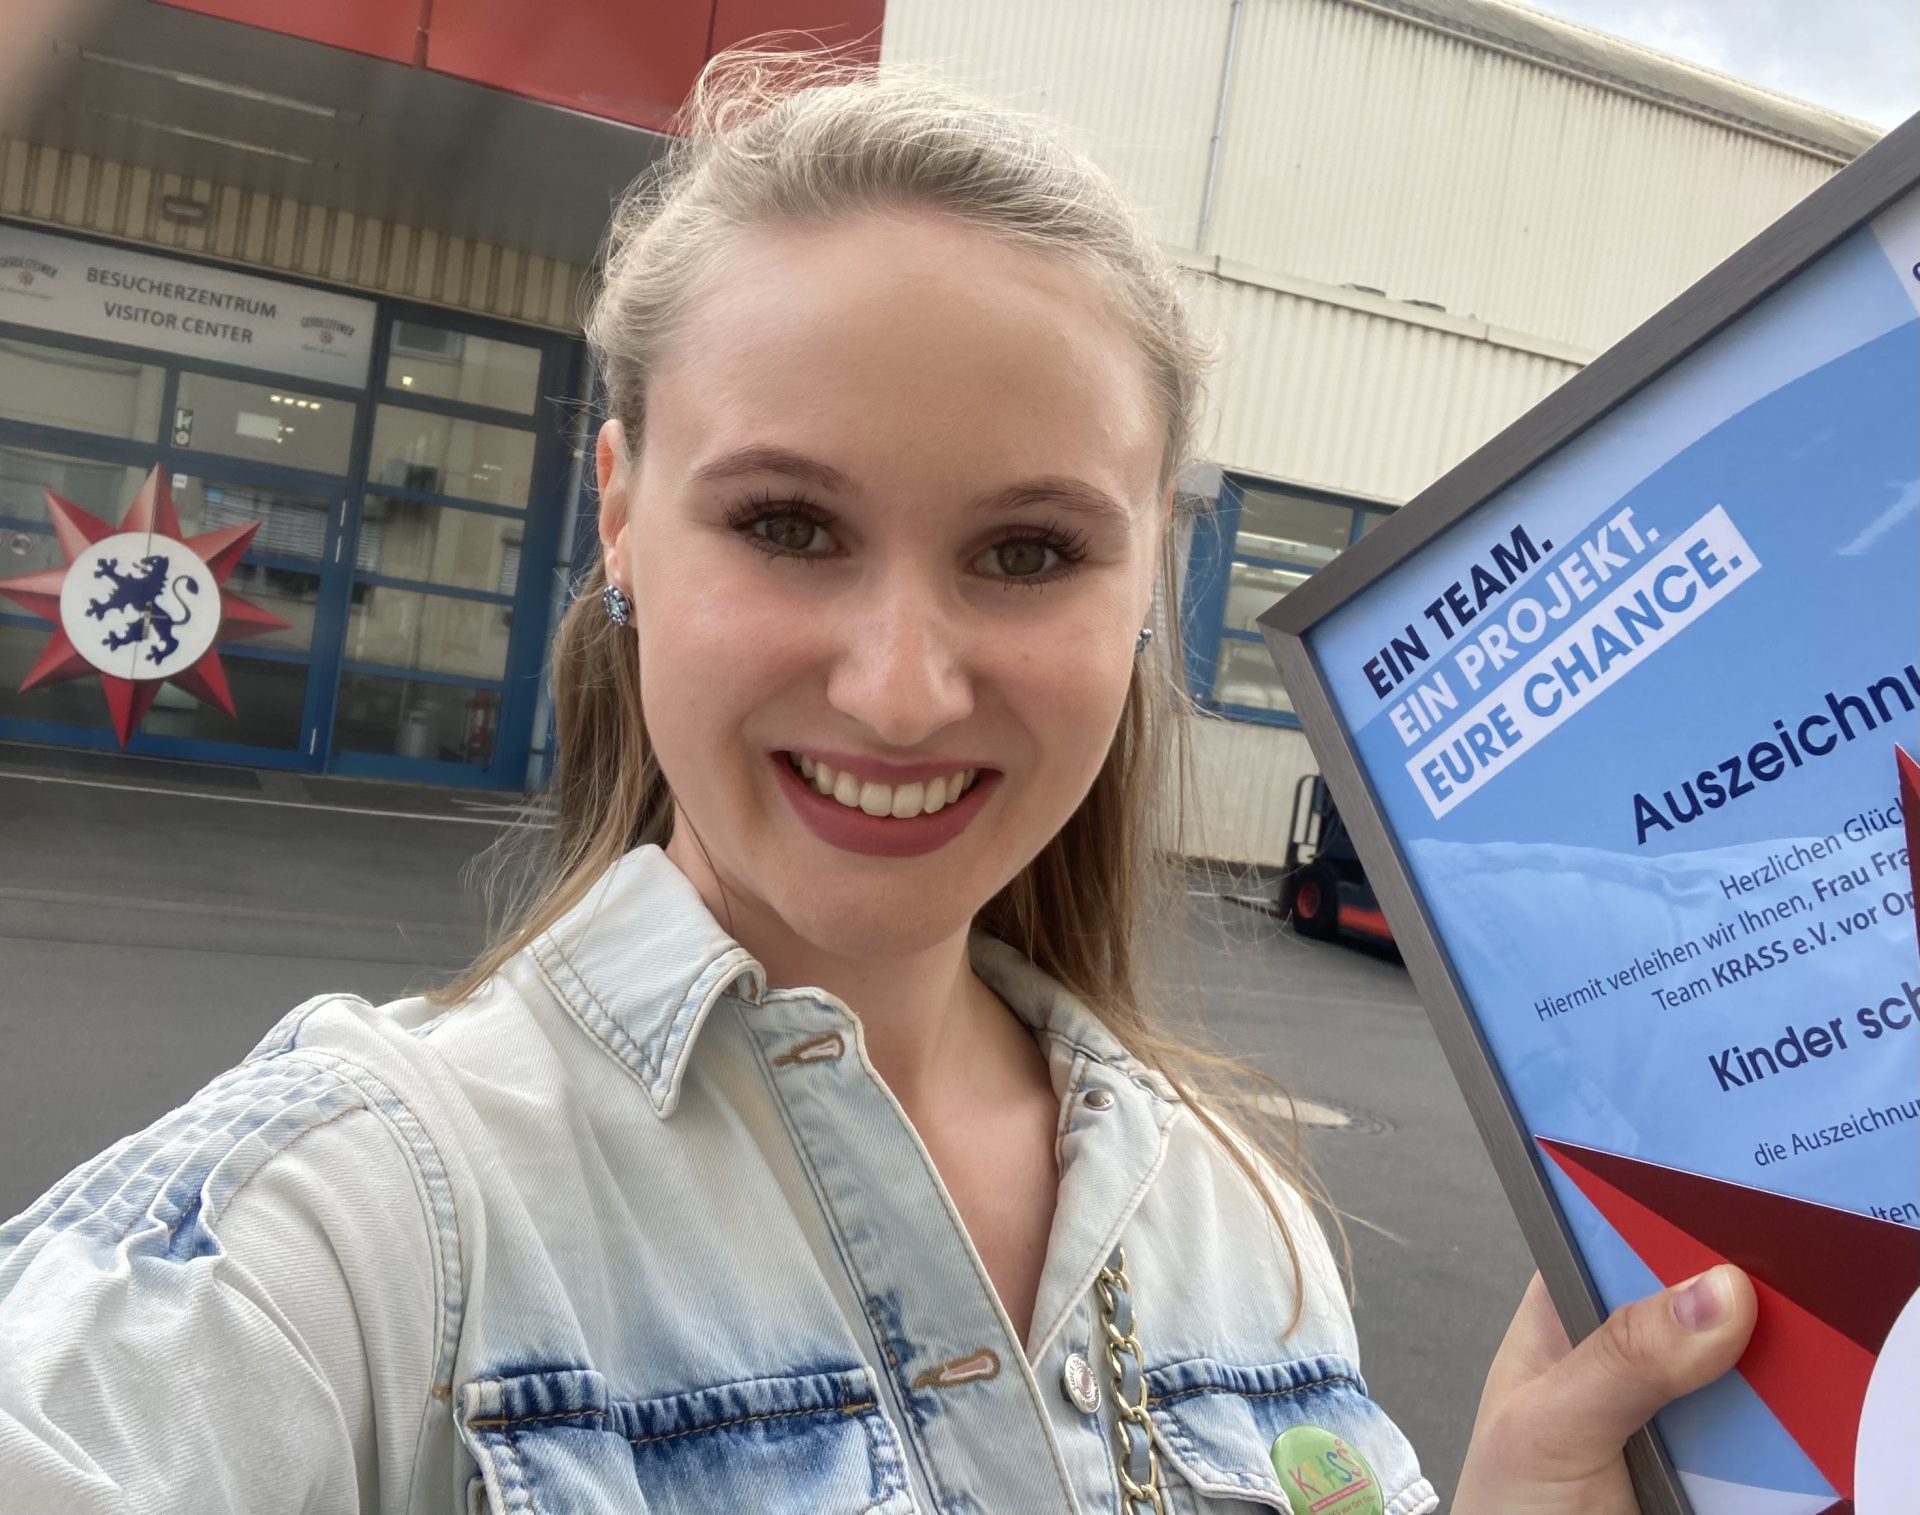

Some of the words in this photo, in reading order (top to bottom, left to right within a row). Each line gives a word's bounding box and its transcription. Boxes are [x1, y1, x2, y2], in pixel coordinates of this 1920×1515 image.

[86, 266, 277, 319] BESUCHERZENTRUM
[103, 301, 177, 330] VISITOR
[181, 316, 254, 343] CENTER
[1362, 623, 1430, 700] EIN
[1423, 523, 1554, 640] TEAM.
[1389, 671, 1459, 747] EIN
[1454, 506, 1661, 691] PROJEKT.
[1420, 702, 1523, 802] EURE
[1523, 538, 1744, 718] CHANCE.
[1719, 834, 1843, 900] Herzlichen
[1534, 978, 1607, 1021] Hiermit
[1606, 940, 1702, 991] verleihen
[1701, 922, 1737, 950] wir
[1738, 894, 1813, 935] Ihnen,
[1811, 866, 1871, 902] Frau
[1651, 976, 1712, 1011] Team
[1711, 940, 1789, 988] KRASS
[1792, 922, 1837, 955] e.V.
[1836, 906, 1879, 936] vor
[1707, 1017, 1848, 1092] Kinder
[1754, 1142, 1789, 1167] die
[1791, 1099, 1920, 1156] Auszeichnu
